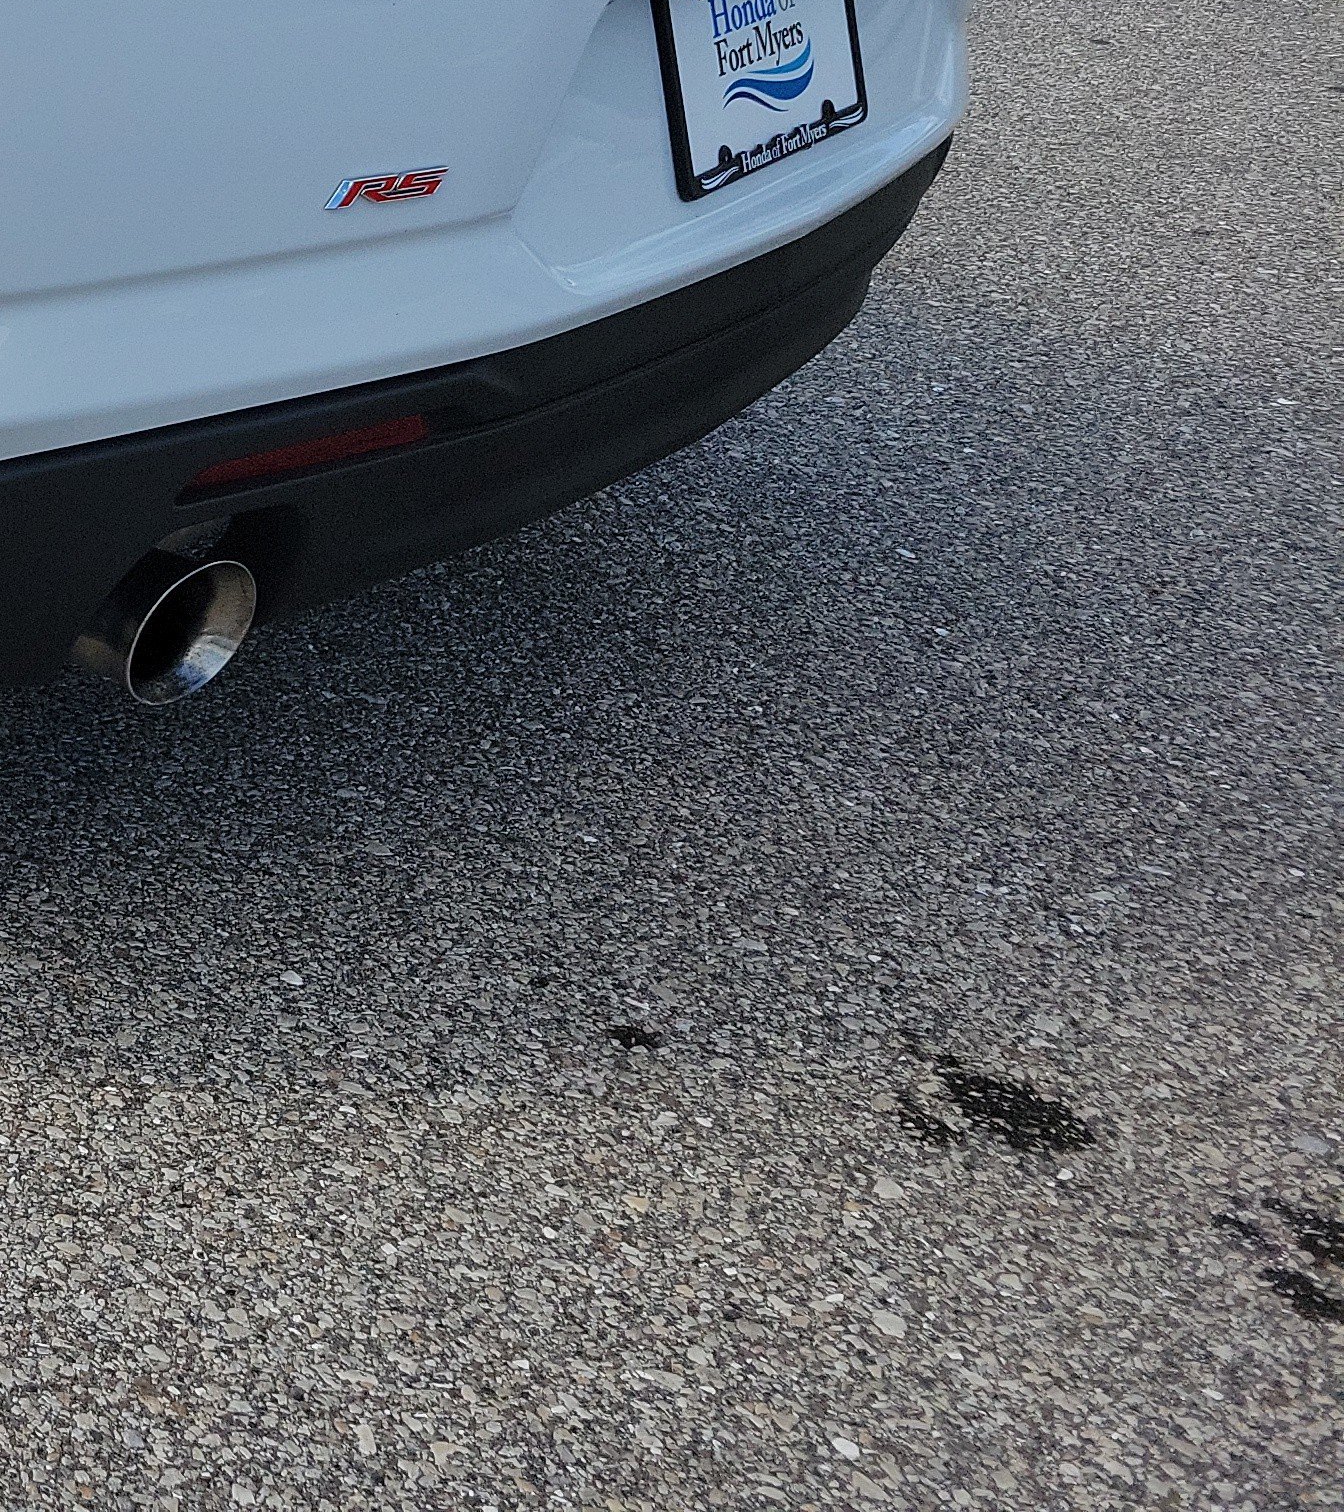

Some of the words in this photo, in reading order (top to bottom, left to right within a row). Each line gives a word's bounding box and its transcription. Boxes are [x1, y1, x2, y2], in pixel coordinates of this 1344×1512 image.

[714, 37, 755, 77] Fort
[752, 20, 804, 66] Myers
[741, 144, 772, 173] Honda
[772, 137, 781, 159] of
[780, 134, 802, 155] Fort
[799, 122, 828, 148] Myers
[325, 166, 450, 210] RS
